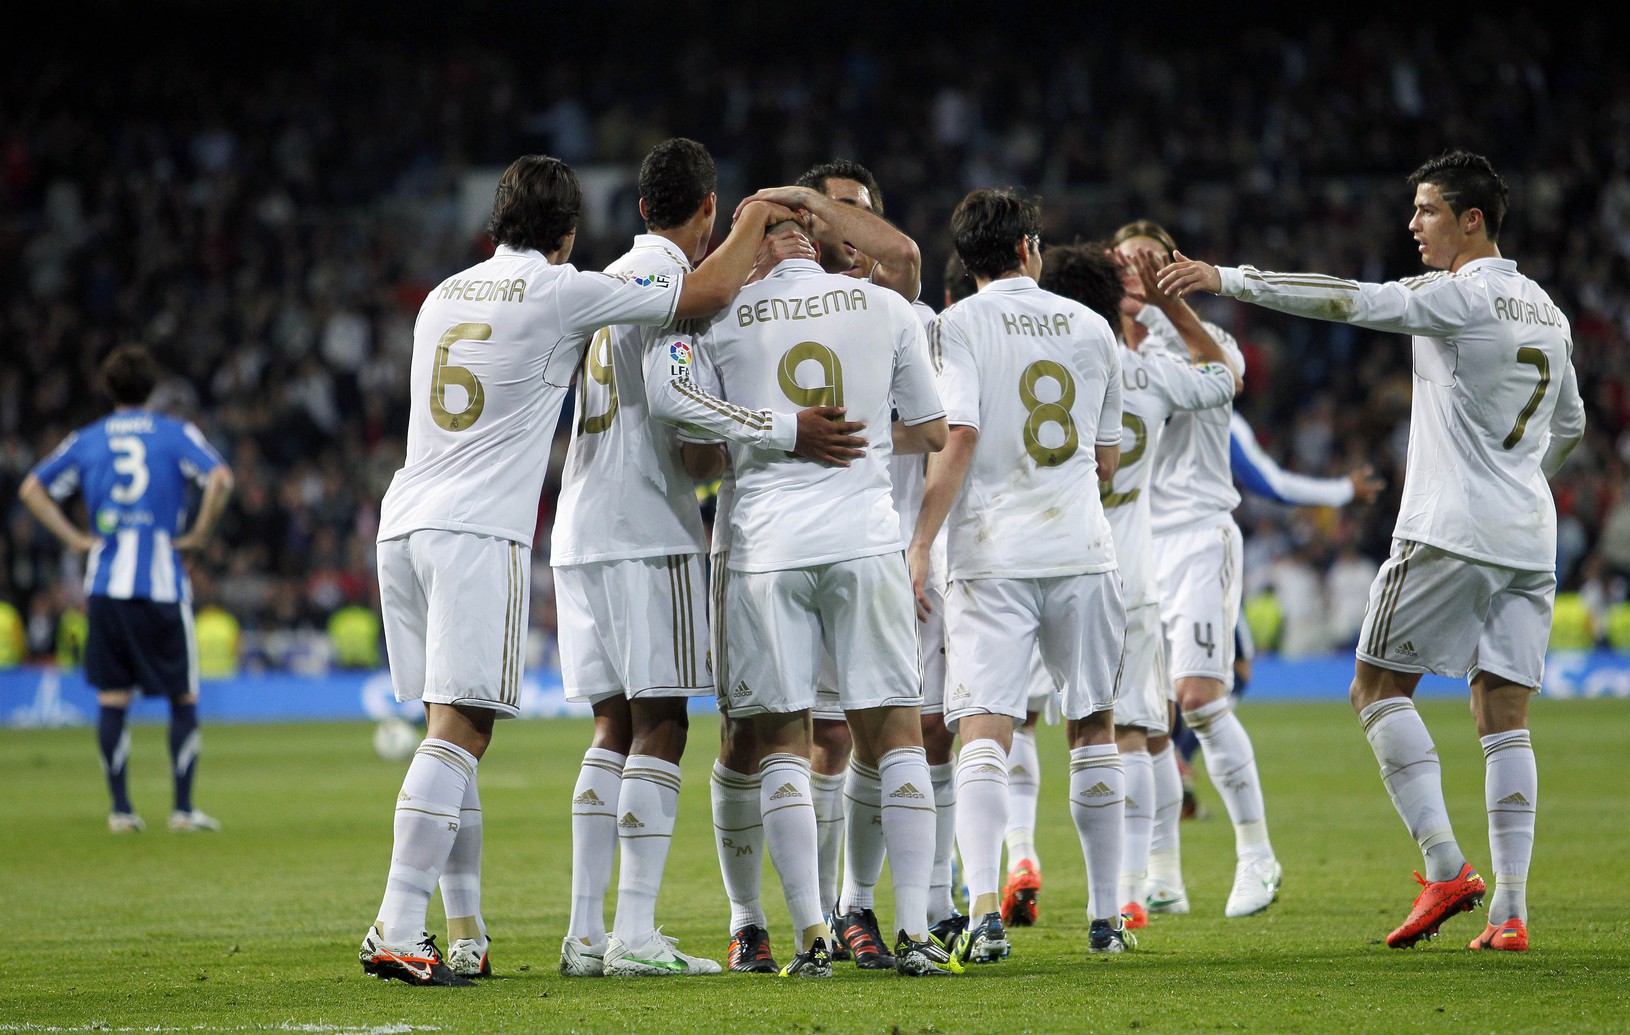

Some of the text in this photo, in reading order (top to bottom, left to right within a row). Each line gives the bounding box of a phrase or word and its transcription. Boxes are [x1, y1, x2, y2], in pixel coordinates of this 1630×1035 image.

[437, 278, 526, 303] KHEDIRA
[737, 289, 867, 327] BENZEMA
[1494, 297, 1562, 328] RONALDO
[430, 323, 492, 431] 6
[777, 341, 846, 424] 9
[1503, 347, 1550, 449] 7
[1019, 359, 1079, 468] 8
[108, 435, 150, 506] 3
[1193, 621, 1215, 658] 4
